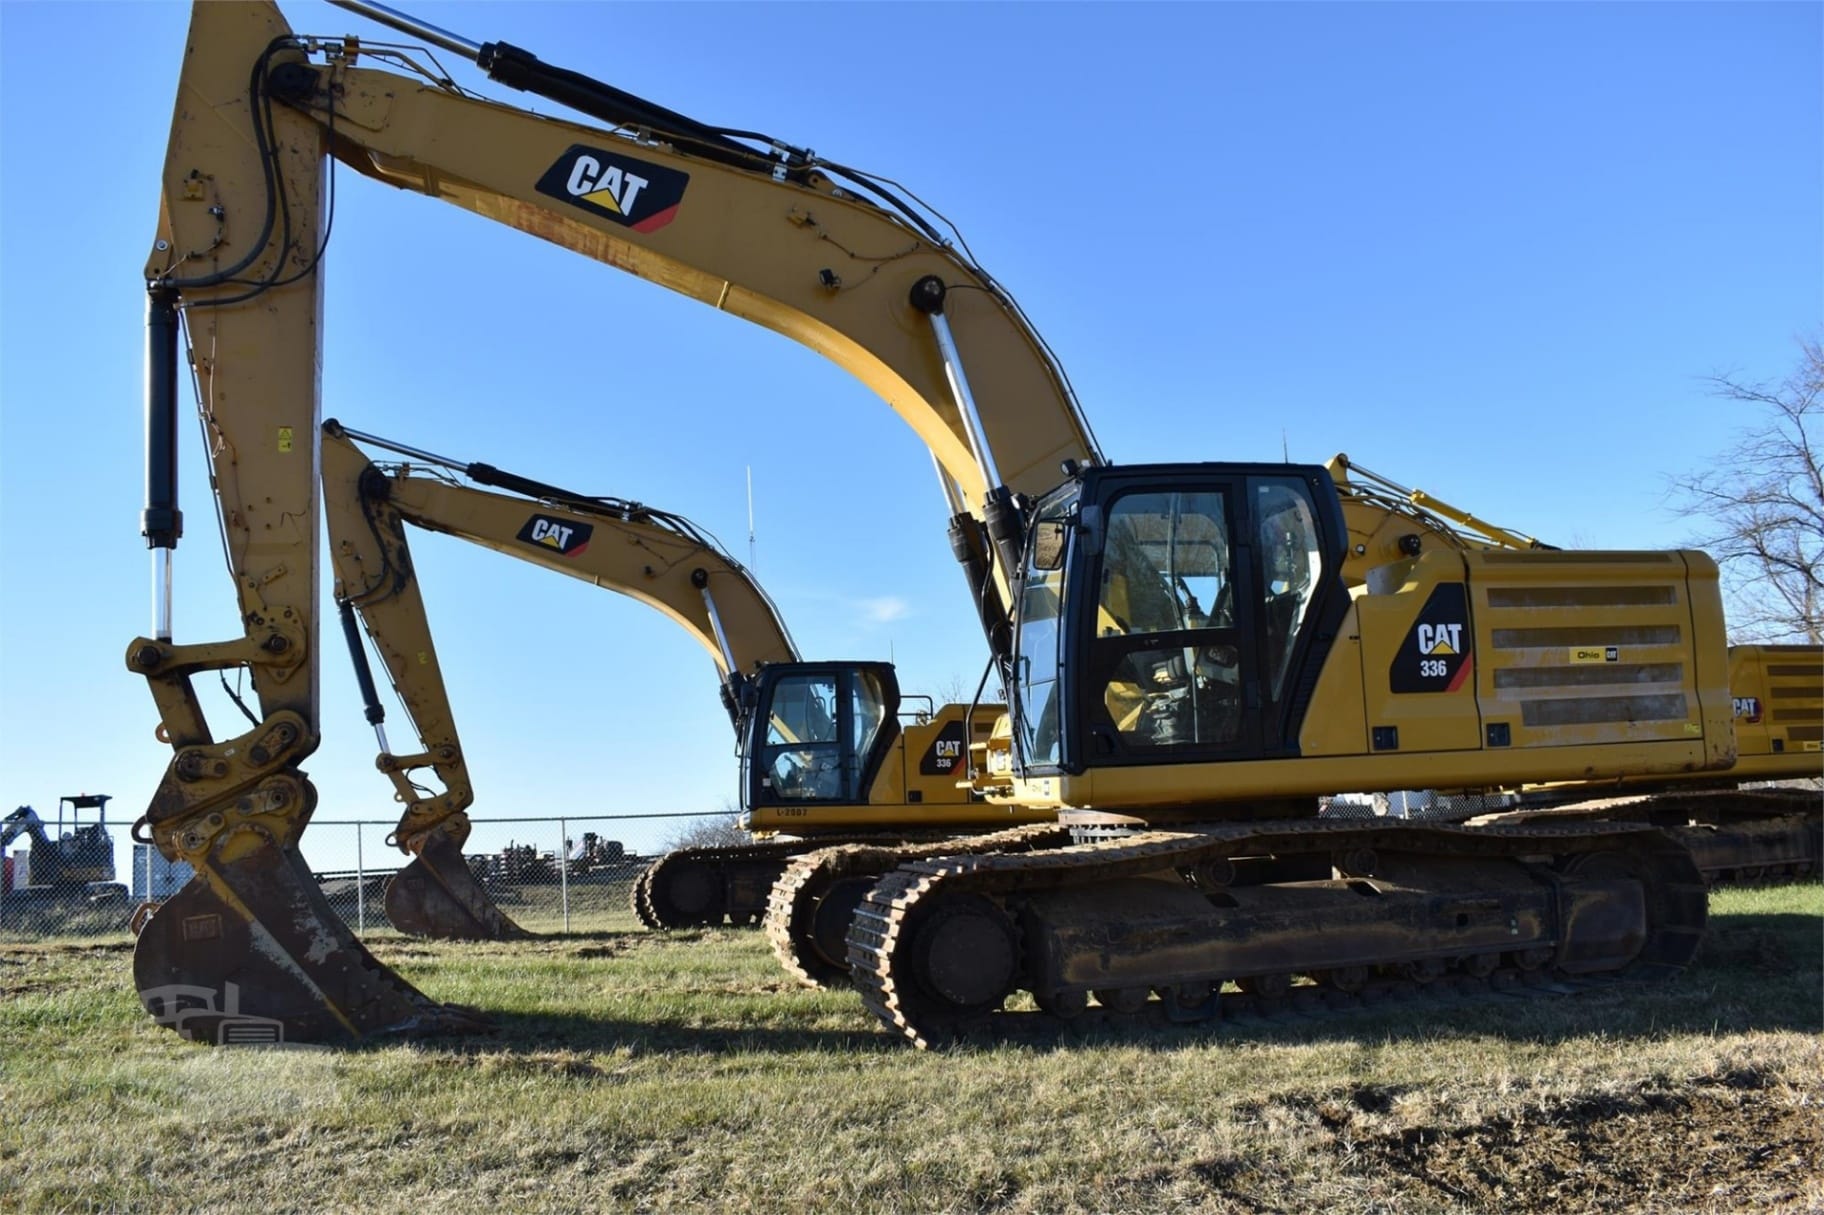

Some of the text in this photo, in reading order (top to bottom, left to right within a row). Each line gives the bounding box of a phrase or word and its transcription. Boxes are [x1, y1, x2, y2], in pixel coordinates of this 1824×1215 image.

[566, 155, 649, 217] CAT
[531, 519, 573, 550] CAT
[1417, 623, 1462, 655] CAT
[1577, 651, 1600, 659] Ohio
[1420, 660, 1448, 677] 336
[1732, 698, 1756, 717] CAT
[936, 740, 960, 757] CAT
[936, 759, 952, 768] 336
